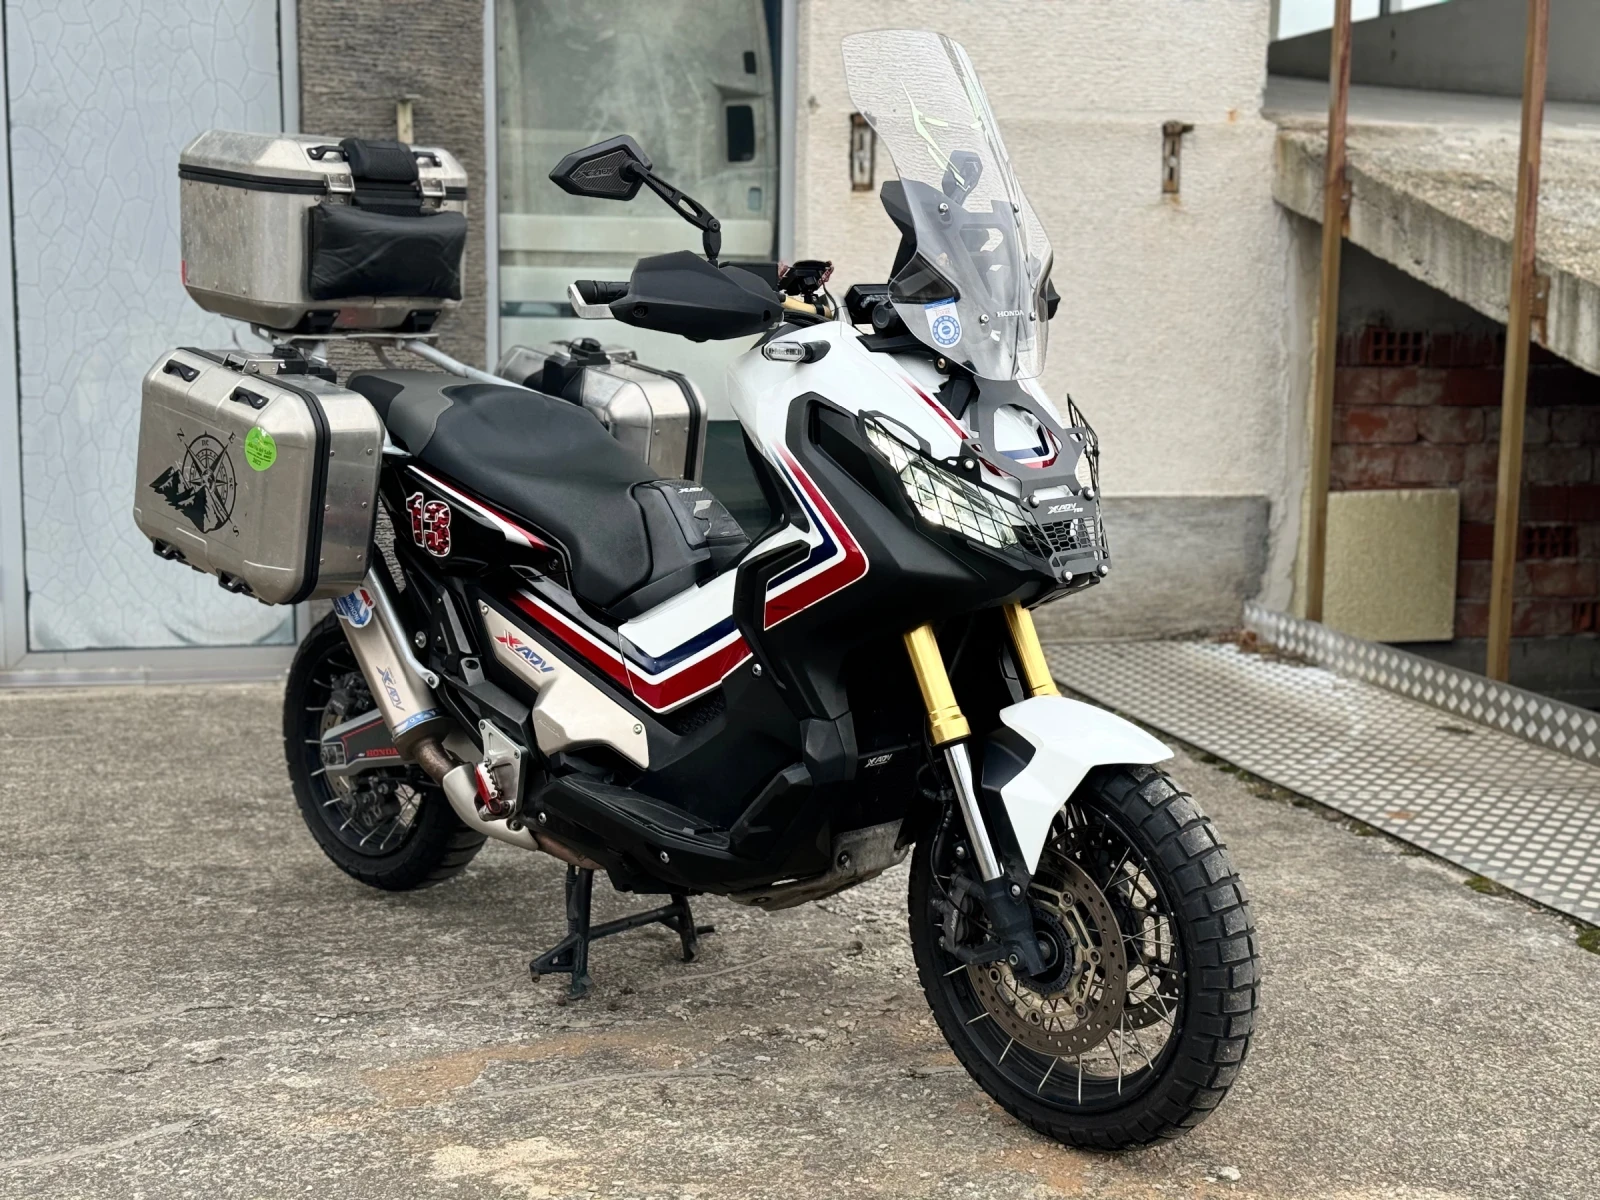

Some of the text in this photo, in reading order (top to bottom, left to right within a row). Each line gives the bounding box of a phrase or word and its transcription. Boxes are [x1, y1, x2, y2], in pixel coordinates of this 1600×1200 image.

[996, 310, 1024, 318] HONDA
[405, 491, 452, 557] 13
[346, 595, 361, 621] MIGNONI
[365, 747, 400, 757] HONDA
